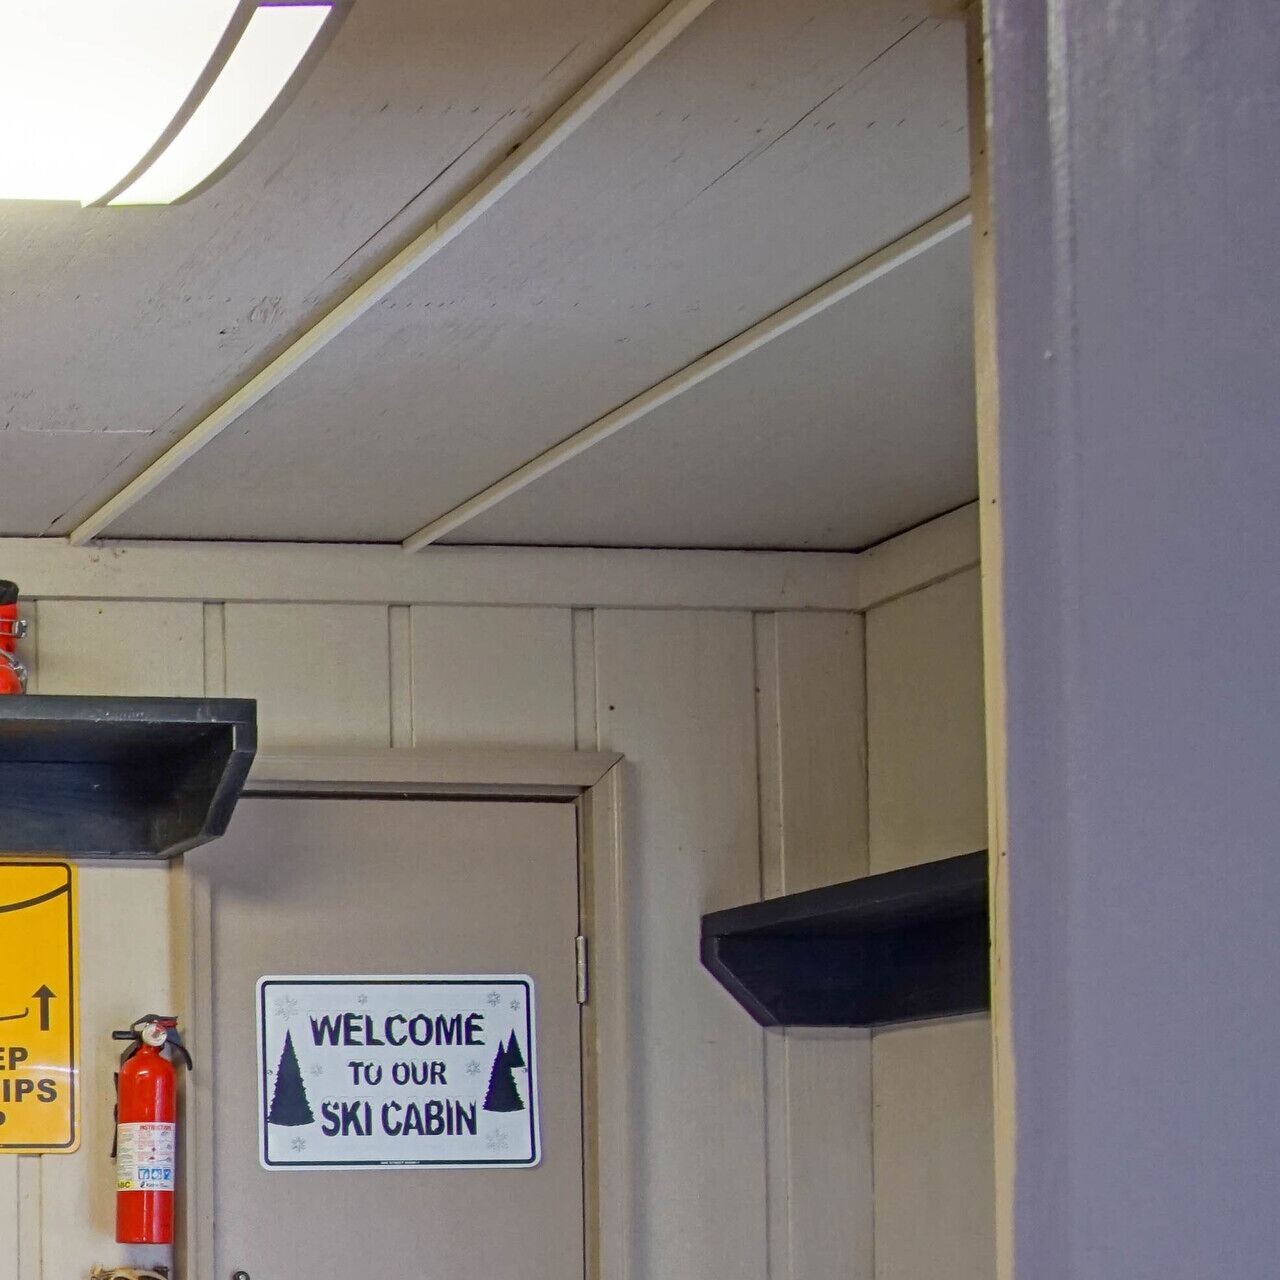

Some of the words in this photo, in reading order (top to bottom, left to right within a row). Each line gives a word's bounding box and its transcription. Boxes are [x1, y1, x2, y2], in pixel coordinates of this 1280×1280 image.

[309, 1011, 486, 1046] WELCOME
[347, 1060, 382, 1085] TO
[391, 1060, 448, 1085] OUR
[321, 1098, 372, 1136] SKI
[381, 1098, 477, 1136] CABIN
